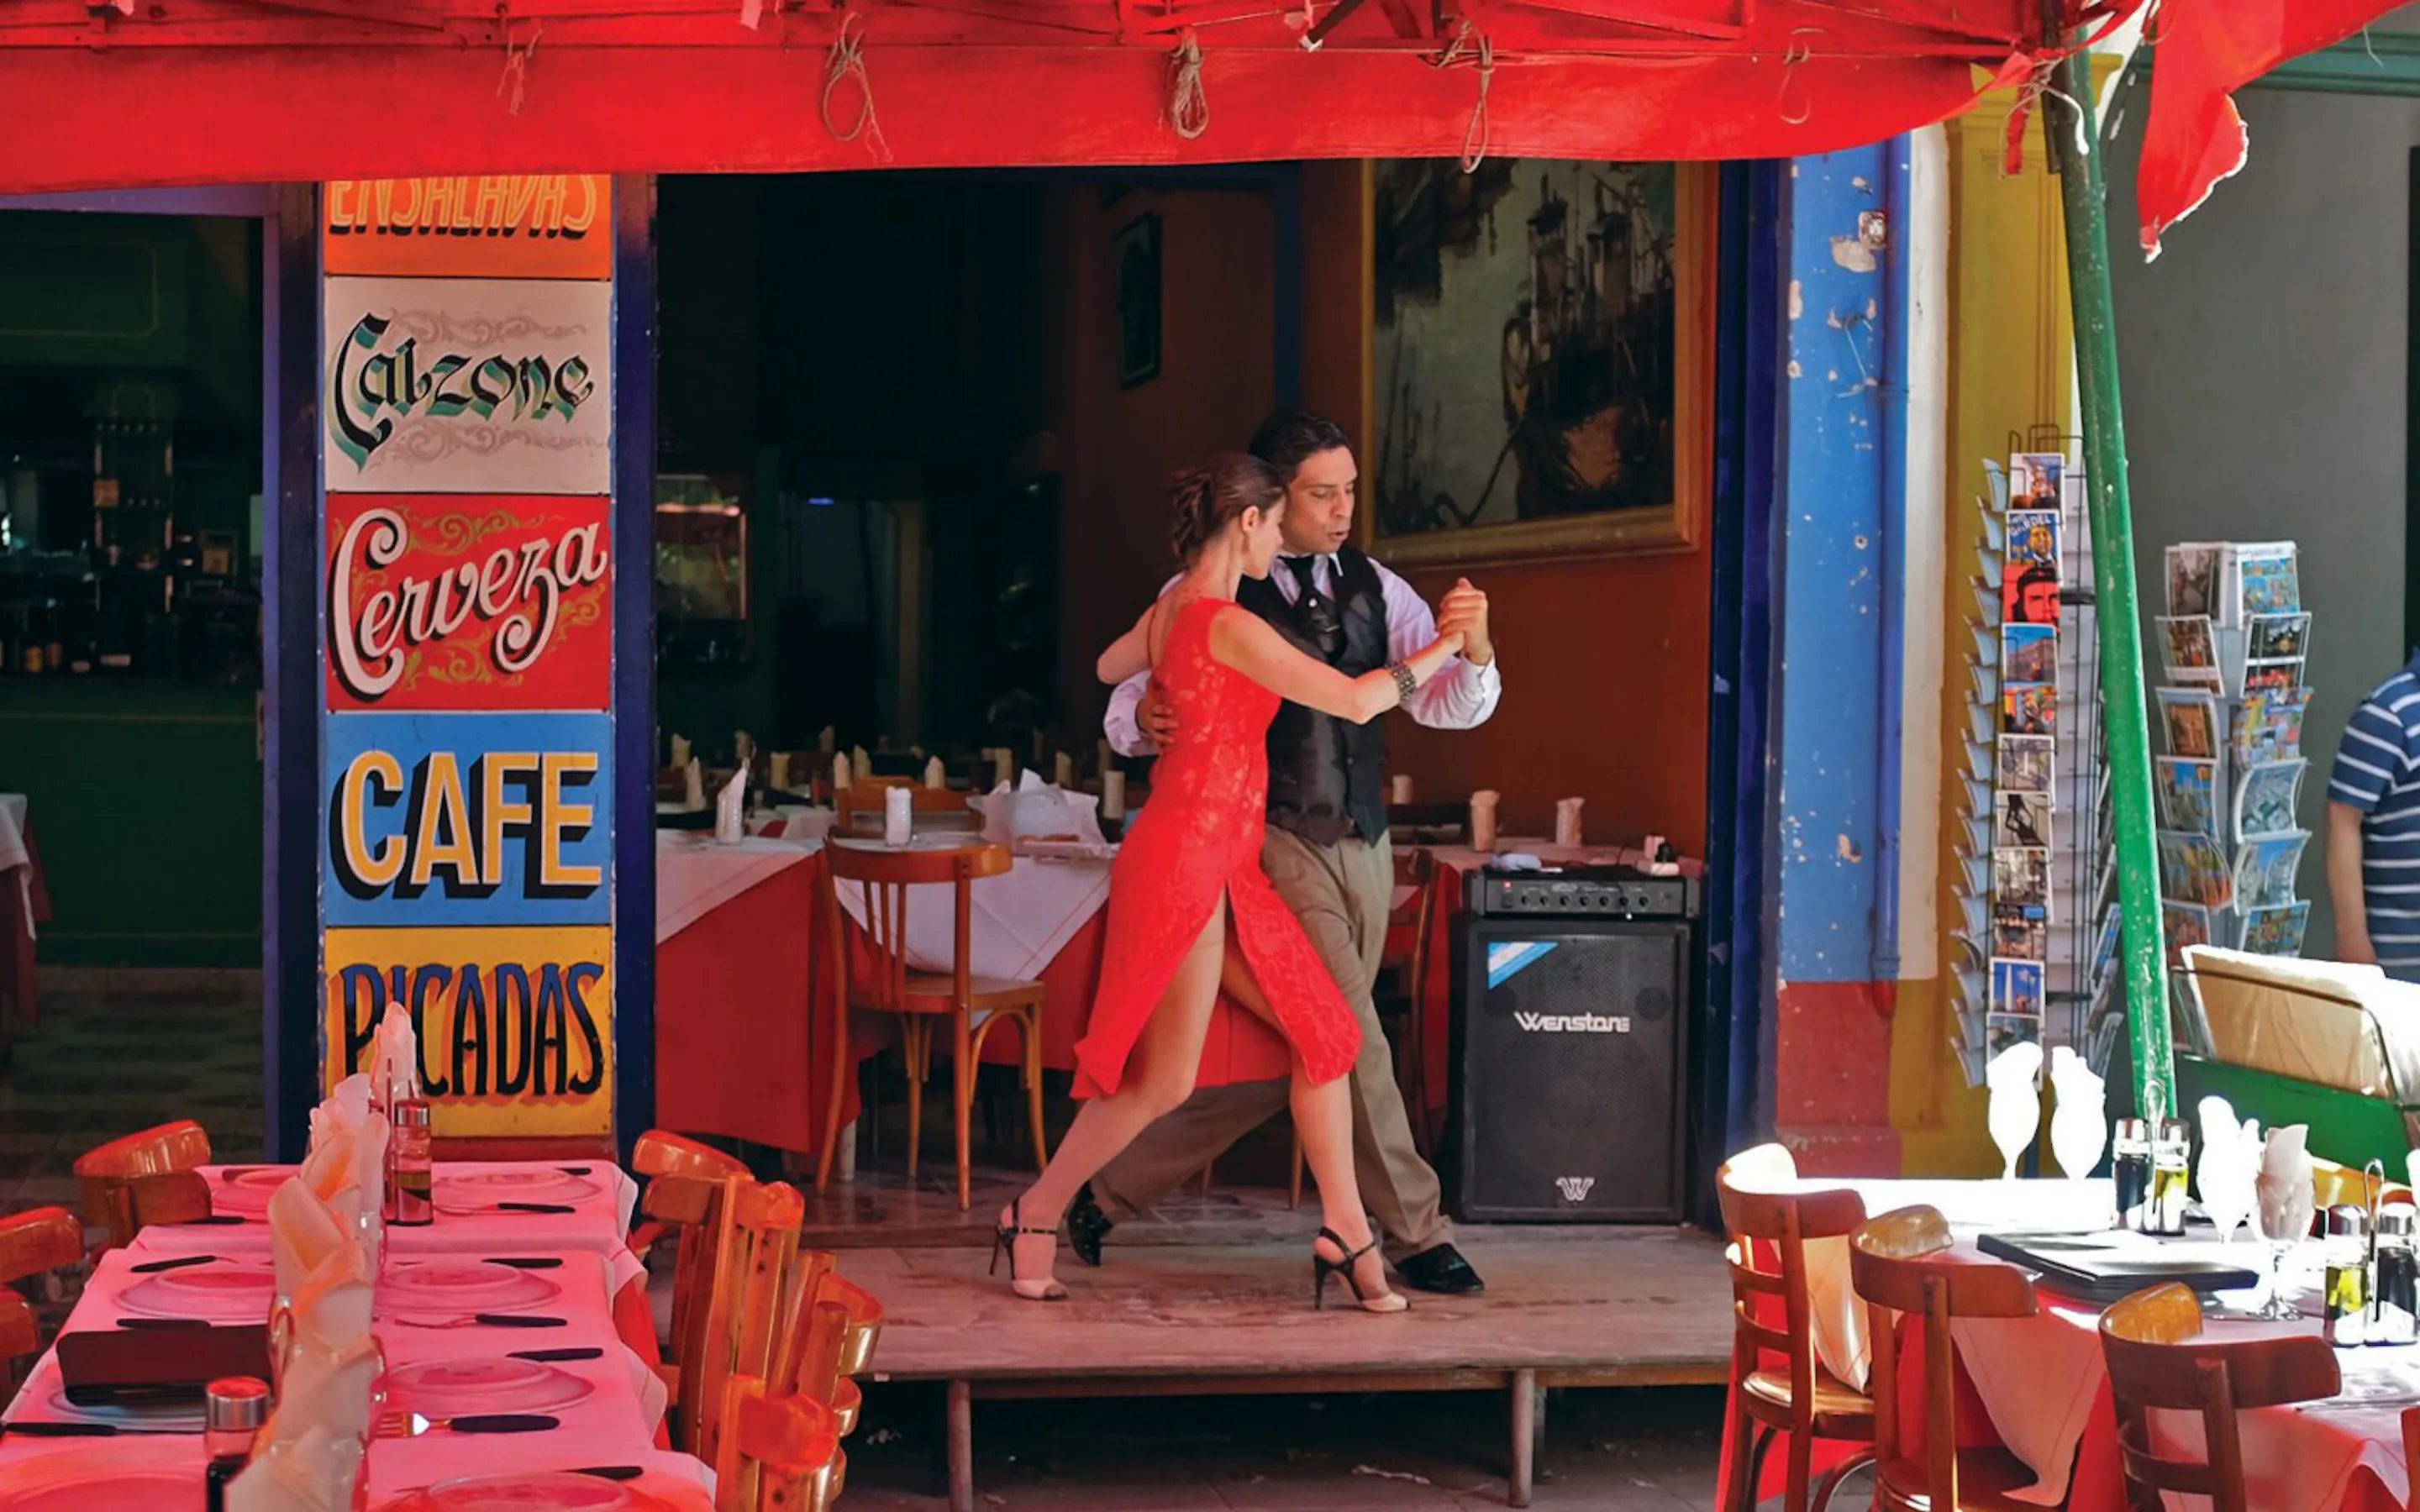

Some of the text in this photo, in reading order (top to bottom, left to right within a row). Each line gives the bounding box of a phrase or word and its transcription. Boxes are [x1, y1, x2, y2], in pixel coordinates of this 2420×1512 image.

[328, 312, 594, 472] Calzone
[328, 508, 608, 701] Cerveza
[330, 750, 602, 900] CAFE
[1513, 1011, 1631, 1033] Wenstone
[1555, 1177, 1596, 1201] W
